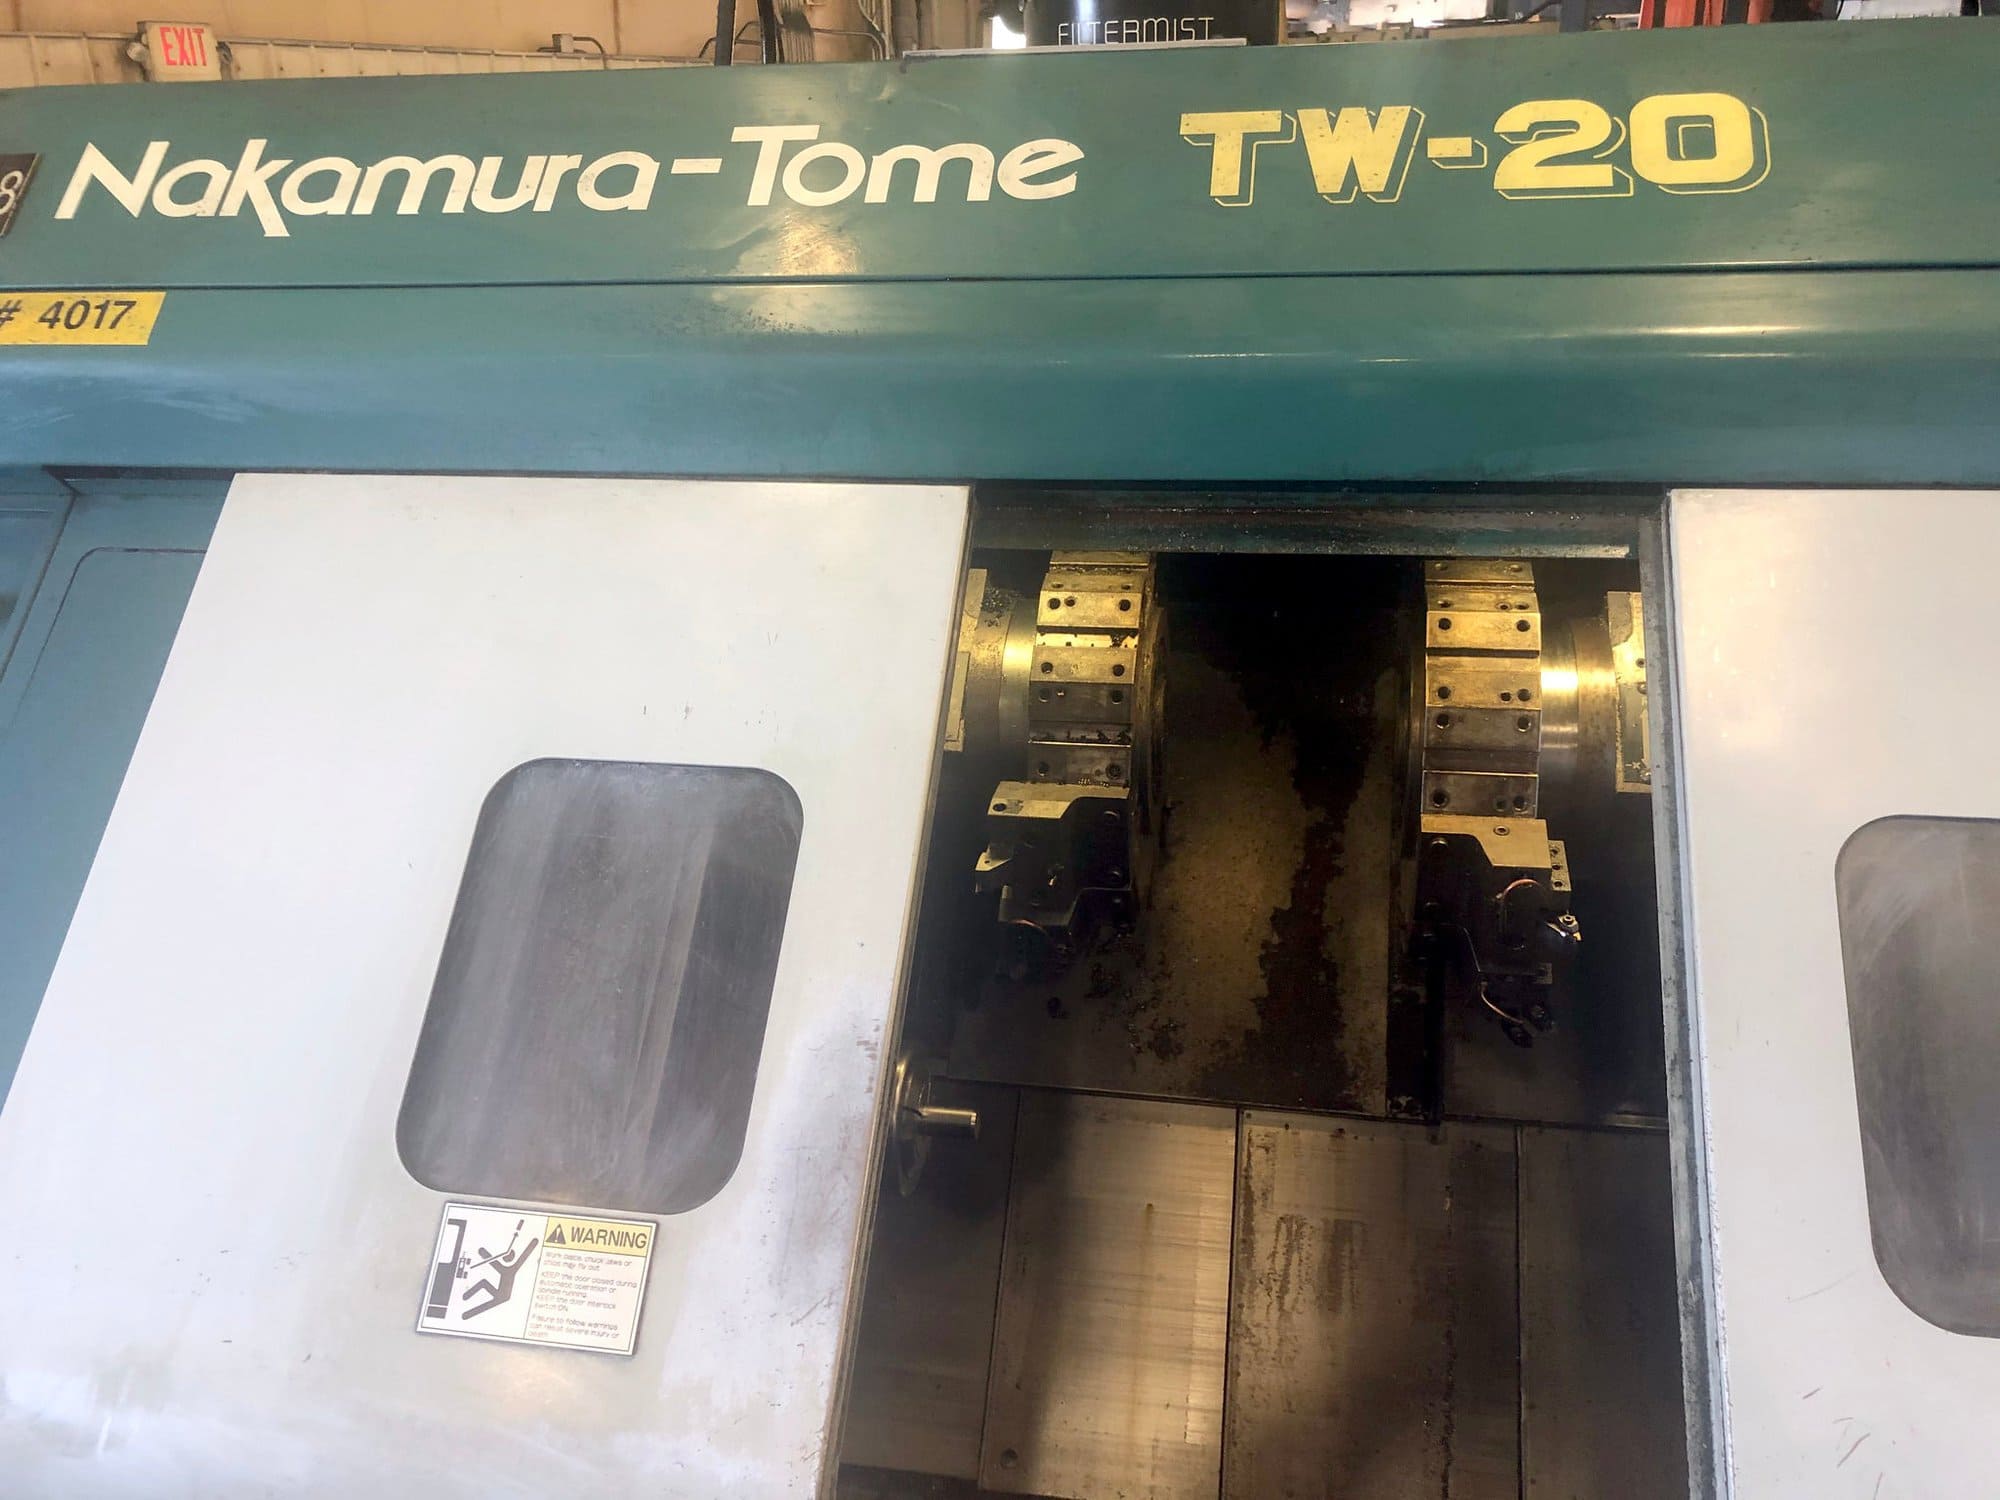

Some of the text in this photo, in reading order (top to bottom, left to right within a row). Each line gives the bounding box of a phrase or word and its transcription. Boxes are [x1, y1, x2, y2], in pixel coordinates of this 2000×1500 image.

[160, 27, 207, 66] EXIT
[1058, 17, 1214, 46] FILTERMIST
[54, 92, 1771, 237] Nakamura-Tome TW-20
[38, 300, 137, 330] 4017
[571, 1226, 647, 1249] WARNING
